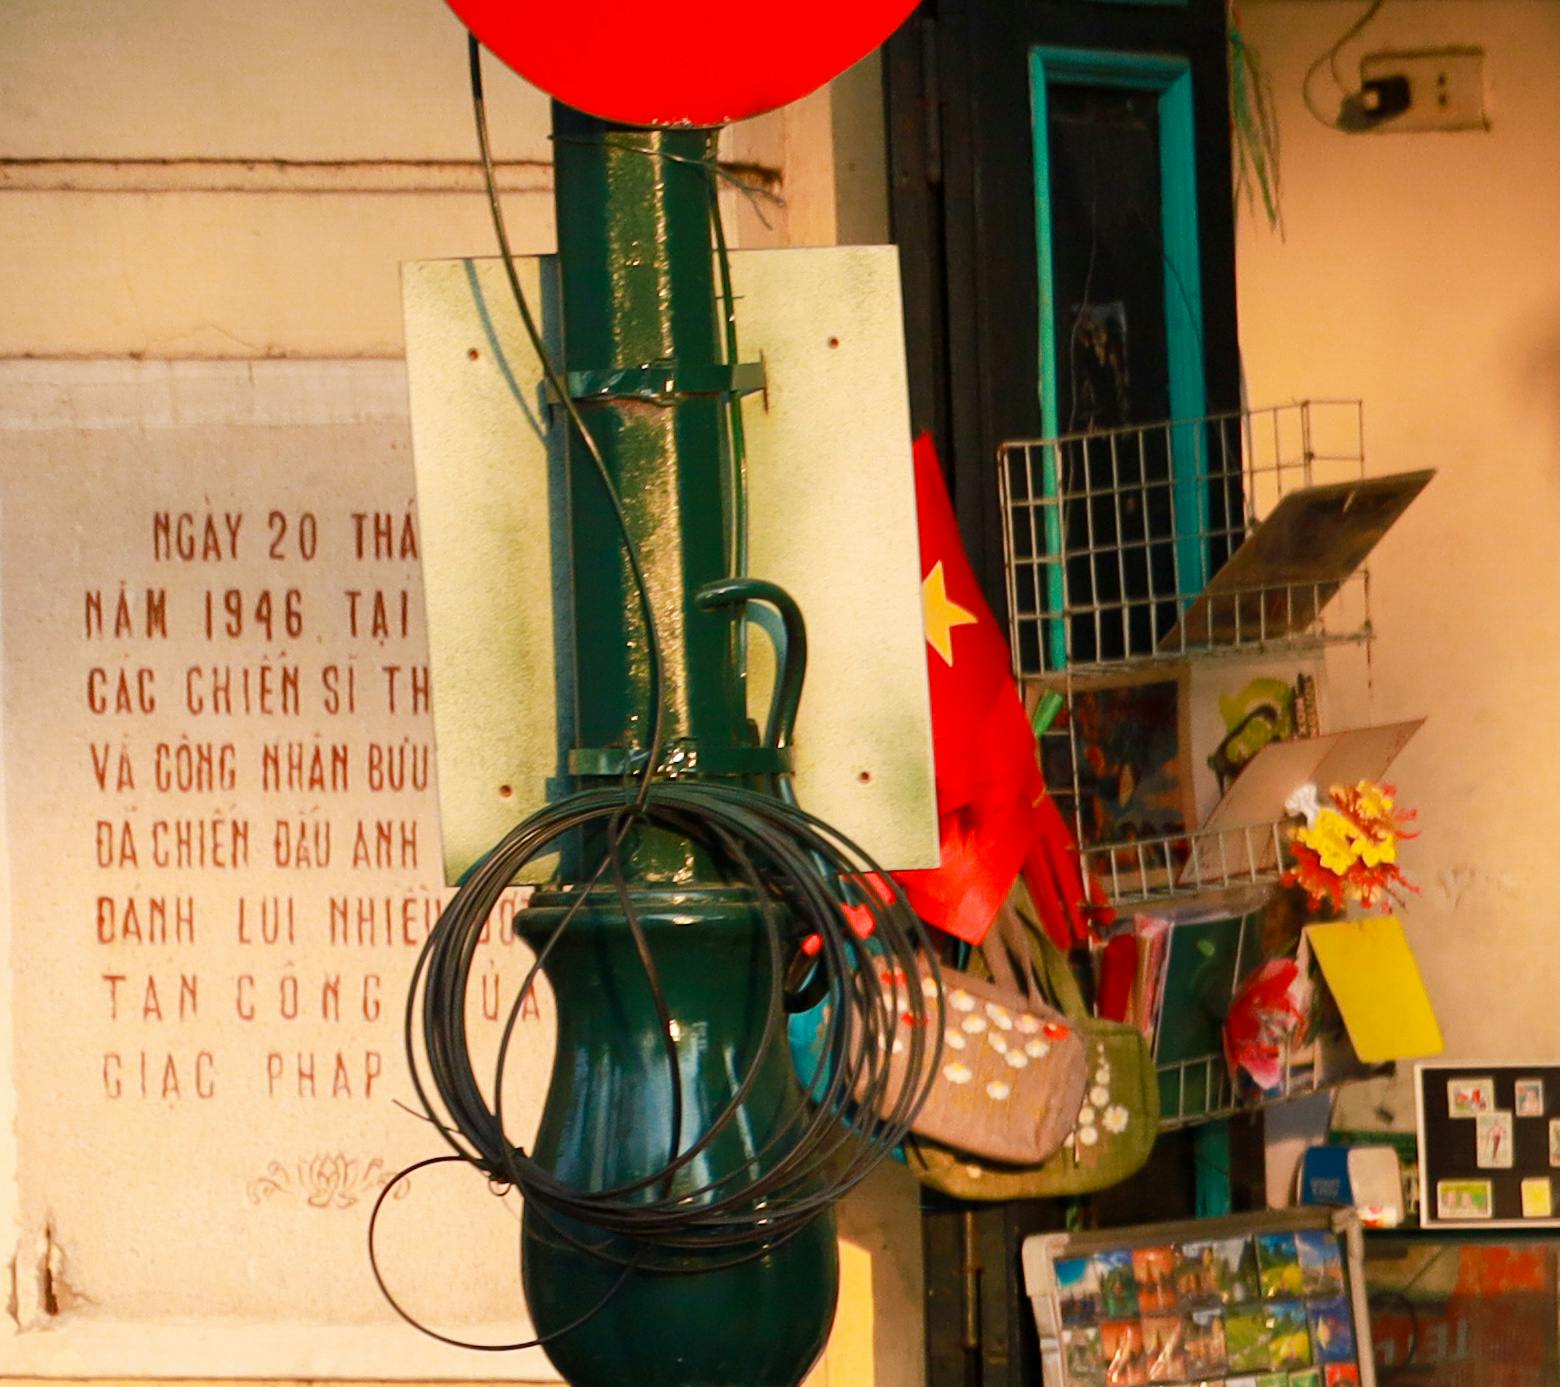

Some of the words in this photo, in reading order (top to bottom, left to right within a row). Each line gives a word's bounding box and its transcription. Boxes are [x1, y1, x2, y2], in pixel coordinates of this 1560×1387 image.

[153, 496, 242, 561] NGÀY
[268, 511, 317, 561] 20
[351, 498, 418, 561] THÁ
[205, 588, 303, 641] 1946
[344, 590, 408, 646] TẠI
[186, 650, 300, 716] CHIẾN
[322, 654, 356, 715] SĨ
[382, 665, 430, 715] TH
[155, 732, 236, 793] CÔNG
[153, 804, 249, 869] CHIẾN
[353, 820, 417, 869] ANH
[482, 958, 540, 1022] ỦA
